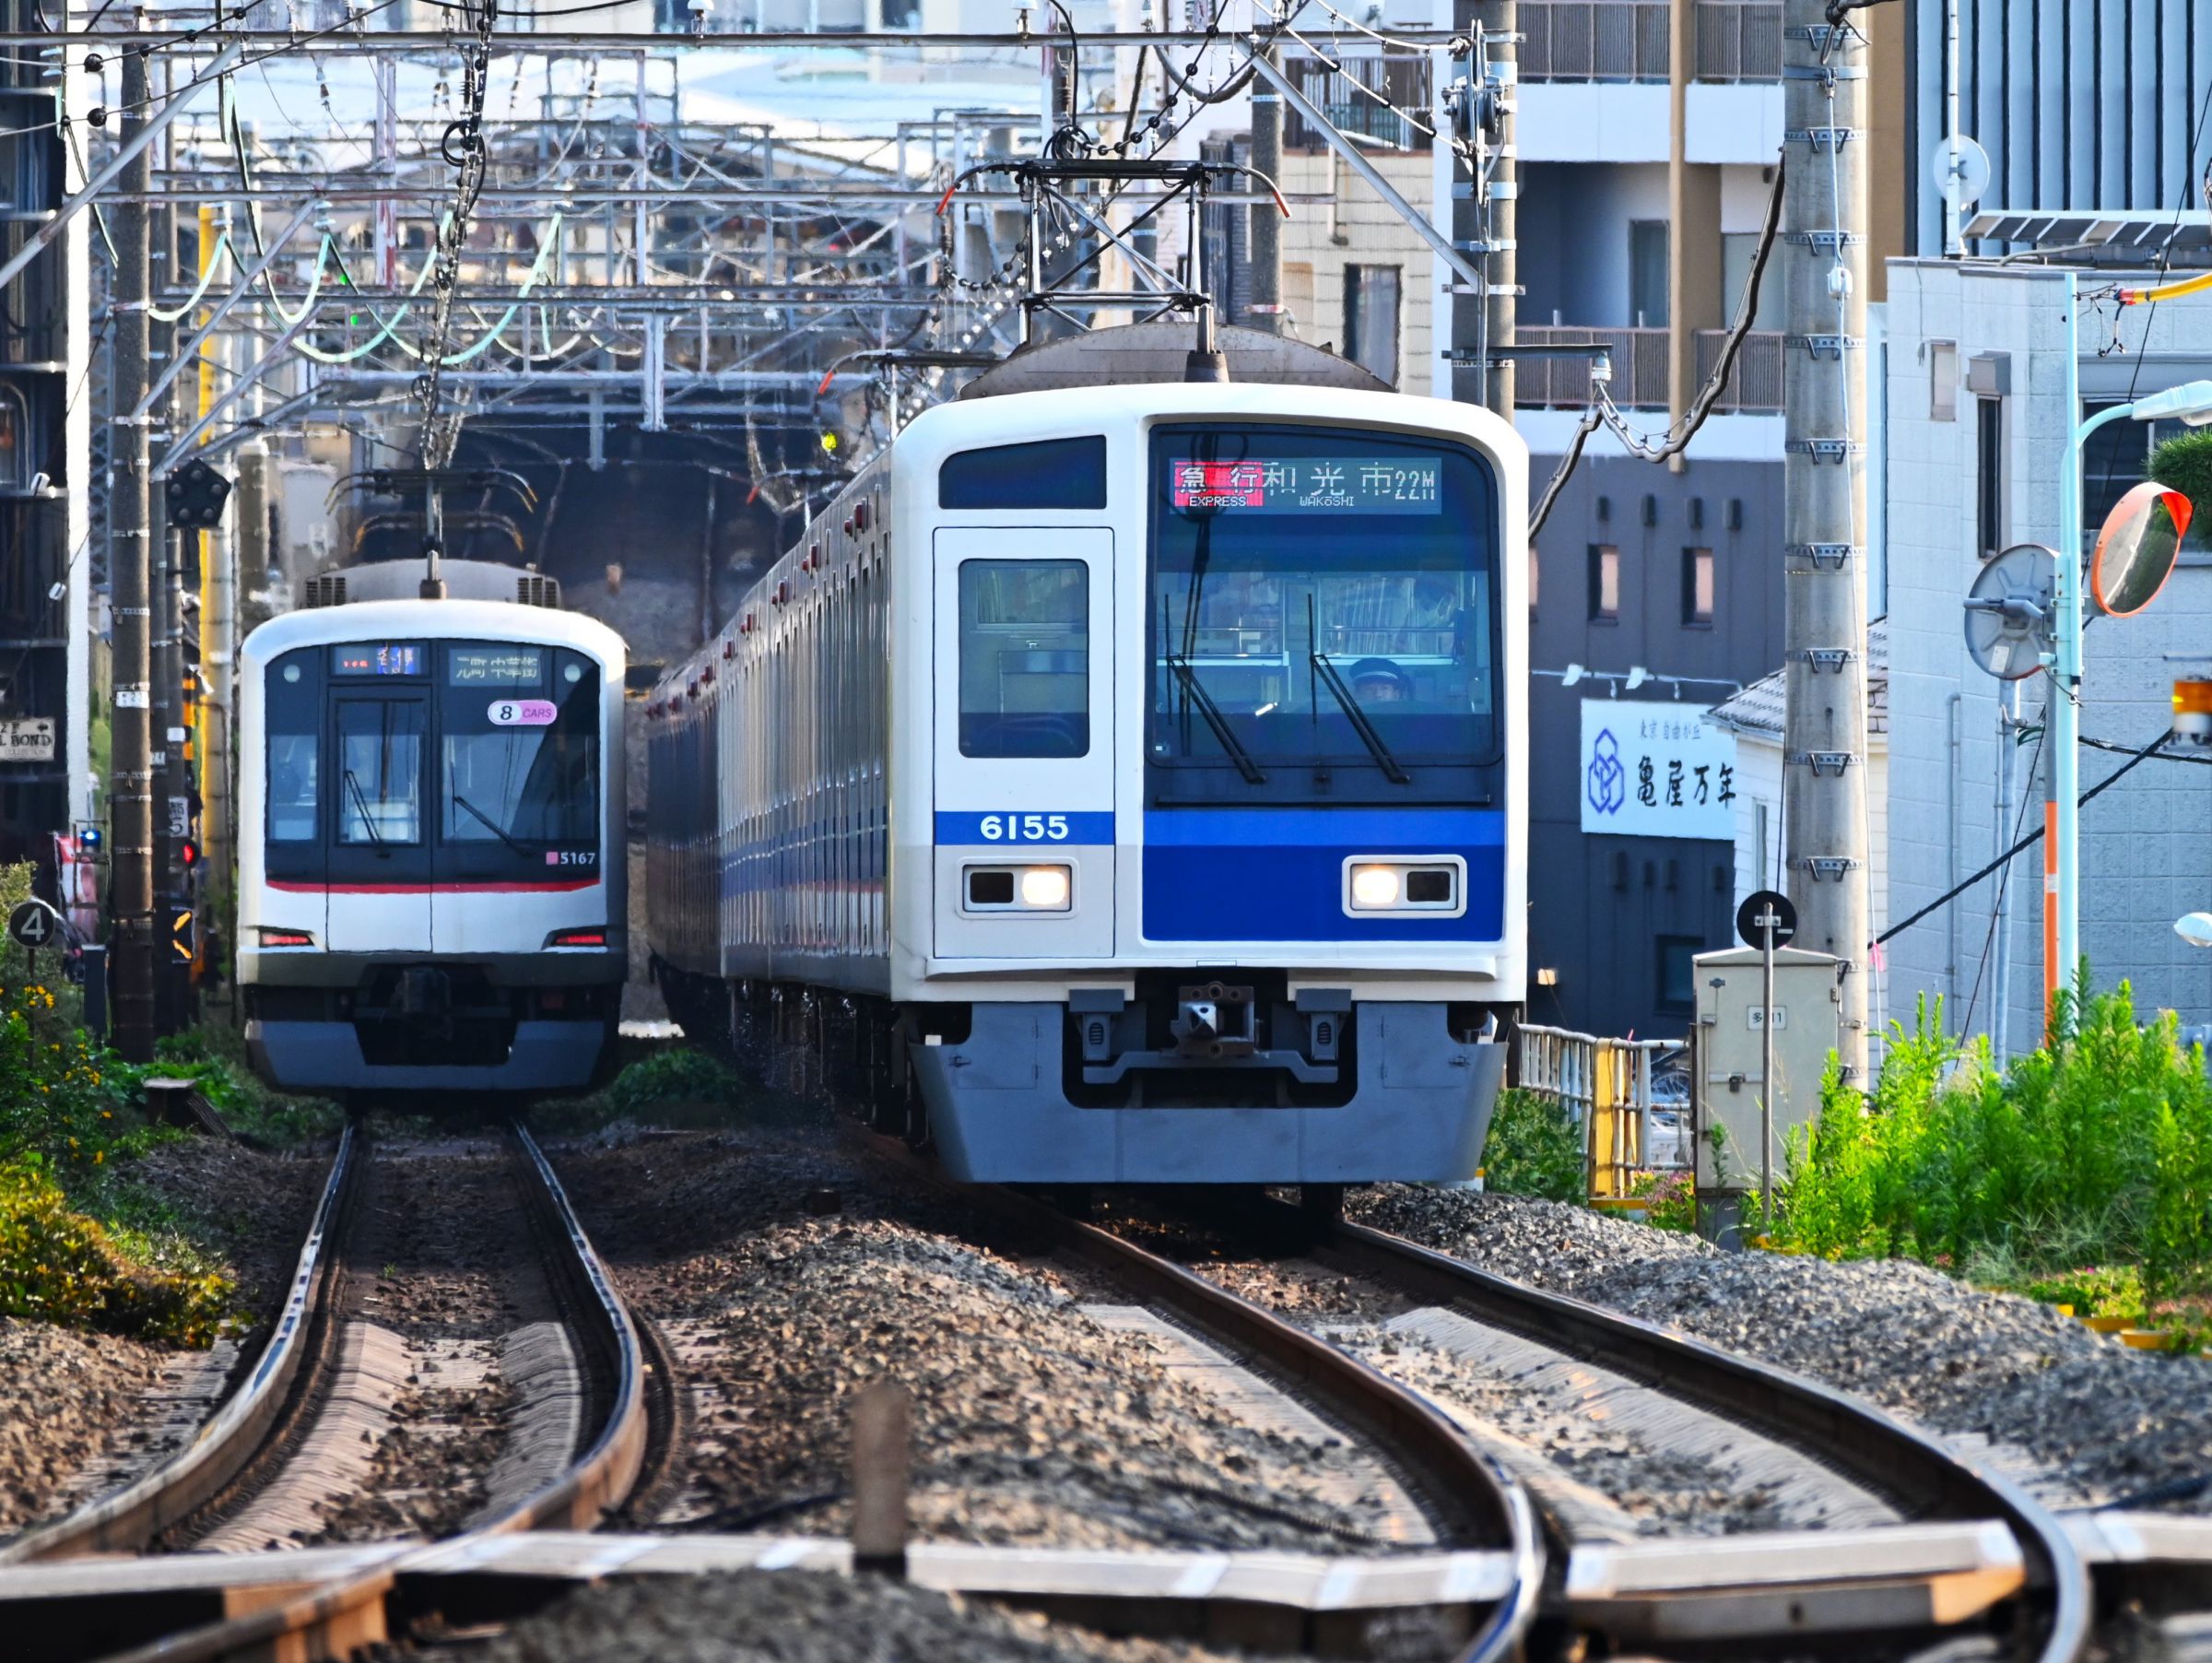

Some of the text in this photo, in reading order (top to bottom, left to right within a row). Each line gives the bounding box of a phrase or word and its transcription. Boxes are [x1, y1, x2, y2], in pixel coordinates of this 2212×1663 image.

[1262, 462, 1394, 495] 和光市
[1189, 495, 1248, 507] EXPRESS
[500, 705, 552, 721] 8 CARS
[11, 734, 52, 748] BOND
[1638, 755, 1736, 810] 亀屋万年
[980, 815, 1069, 841] 6155
[559, 852, 596, 867] 5167
[20, 907, 46, 942] 4
